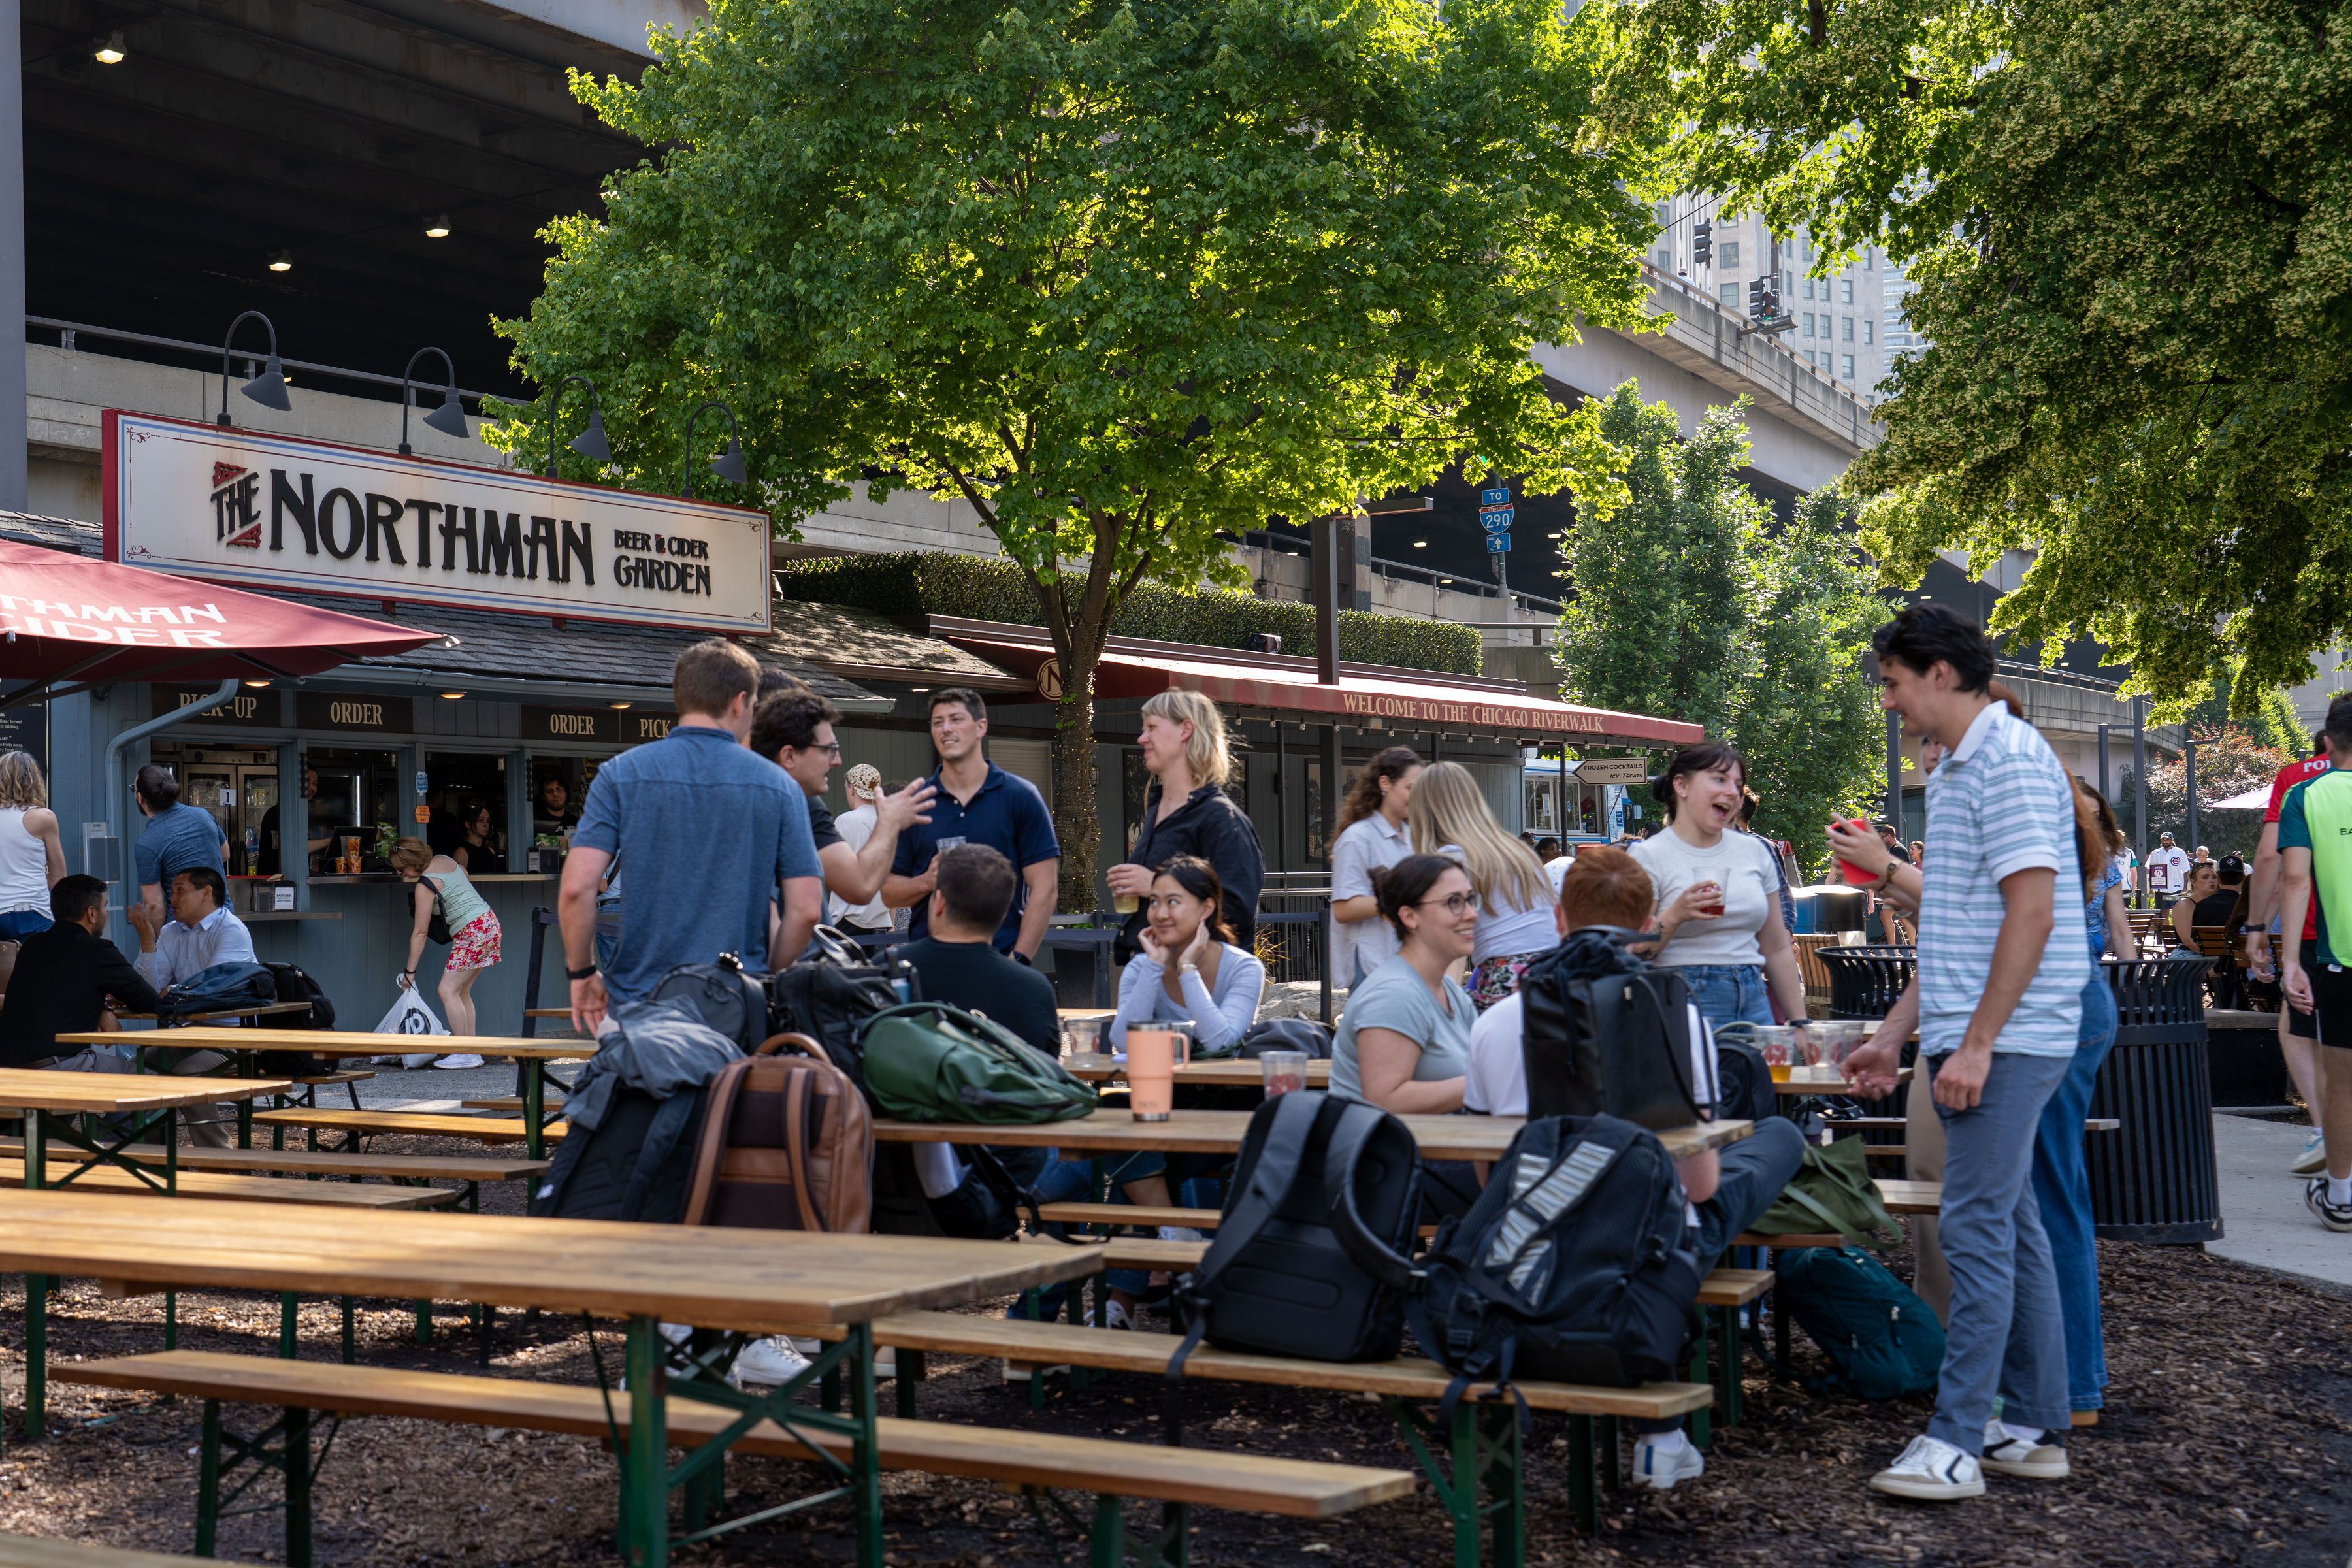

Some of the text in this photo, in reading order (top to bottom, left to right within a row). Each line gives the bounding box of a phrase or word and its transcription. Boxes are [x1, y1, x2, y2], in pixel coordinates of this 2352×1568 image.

[1489, 492, 1502, 501] TO
[210, 468, 596, 586] THE NORTHMAN
[1486, 513, 1510, 529] 290
[614, 529, 652, 551] BEER
[667, 536, 710, 559] CIDER
[613, 555, 711, 596] GARDEN
[330, 701, 384, 725] ORDER
[549, 713, 595, 736] ORDER
[1342, 693, 1605, 732] WELCOME TO THE CHICAGO RIVERWALK
[225, 792, 230, 803] 1
